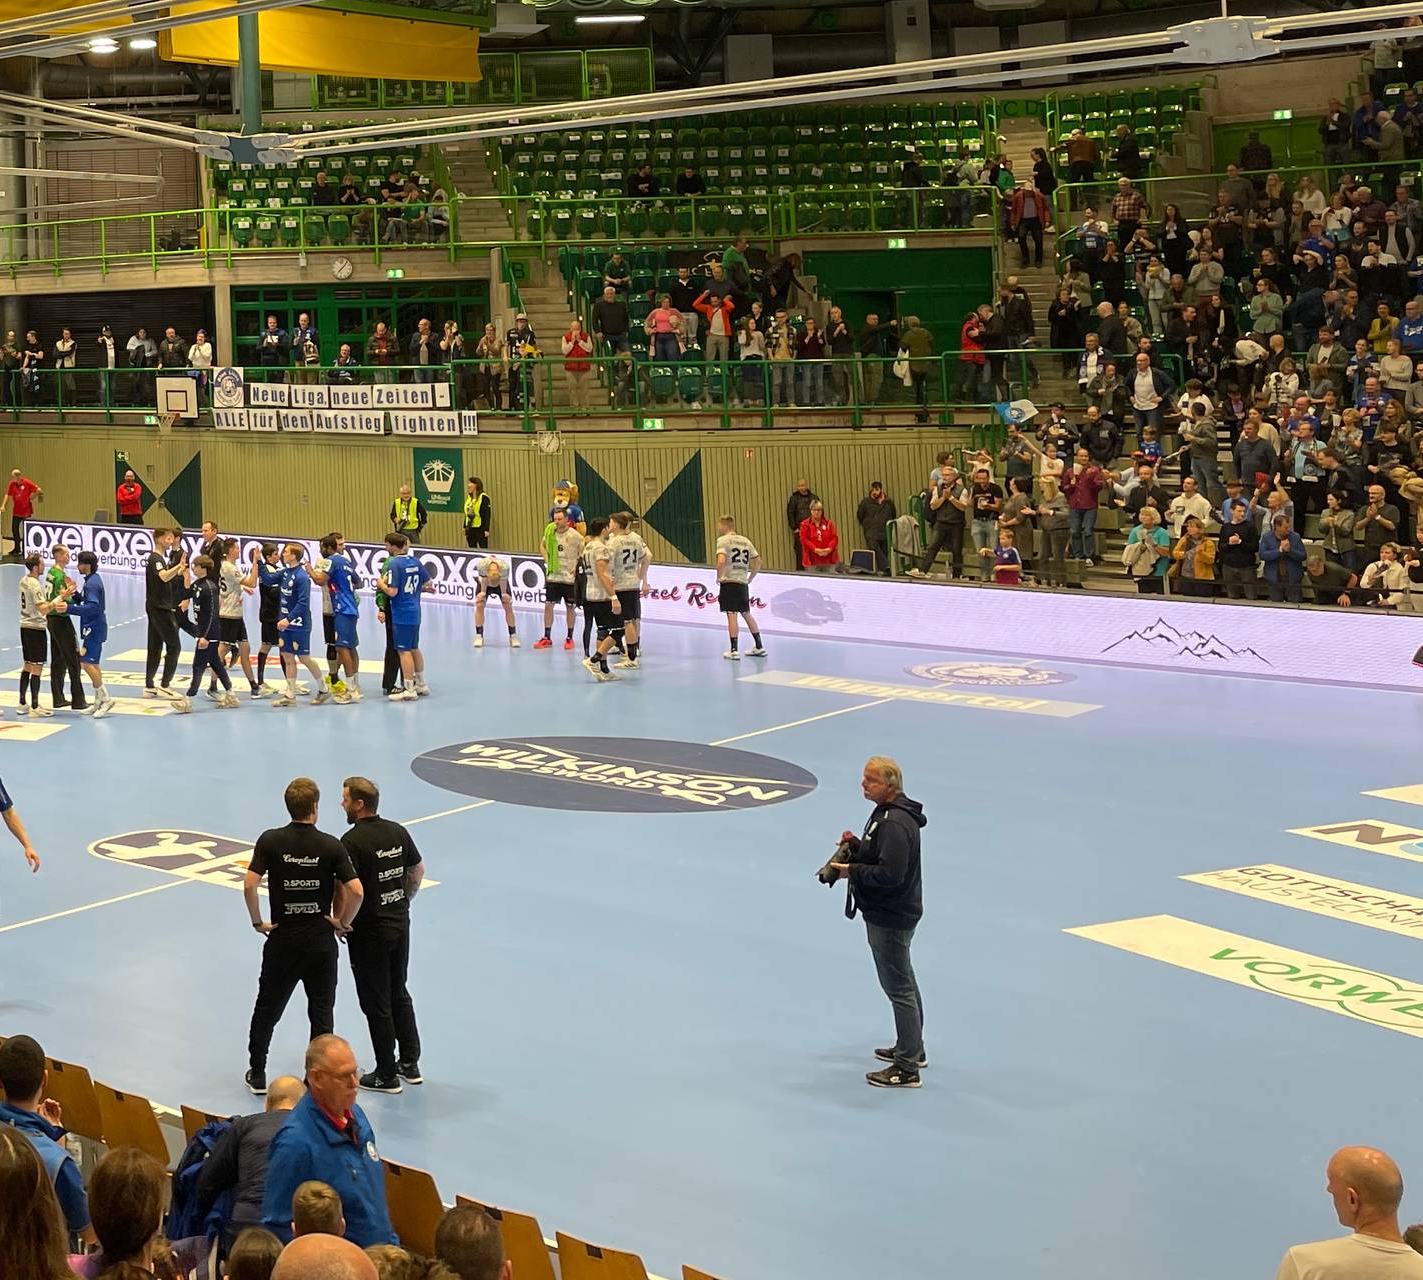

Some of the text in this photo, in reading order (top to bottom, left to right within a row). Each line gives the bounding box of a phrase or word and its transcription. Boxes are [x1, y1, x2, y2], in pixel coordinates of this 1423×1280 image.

[252, 386, 286, 403] Neue
[333, 391, 369, 405] neue
[376, 388, 429, 404] Zeiten
[215, 411, 245, 427] ALLE
[253, 411, 274, 427] für
[282, 412, 310, 429] den
[316, 413, 381, 432] Aufstieg
[394, 415, 457, 433] fighten
[27, 524, 82, 552] oxe
[94, 529, 153, 556] oxe
[622, 548, 638, 565] 71
[731, 548, 750, 564] 23
[459, 744, 789, 801] WILKINSON
[532, 766, 655, 789] SWORD
